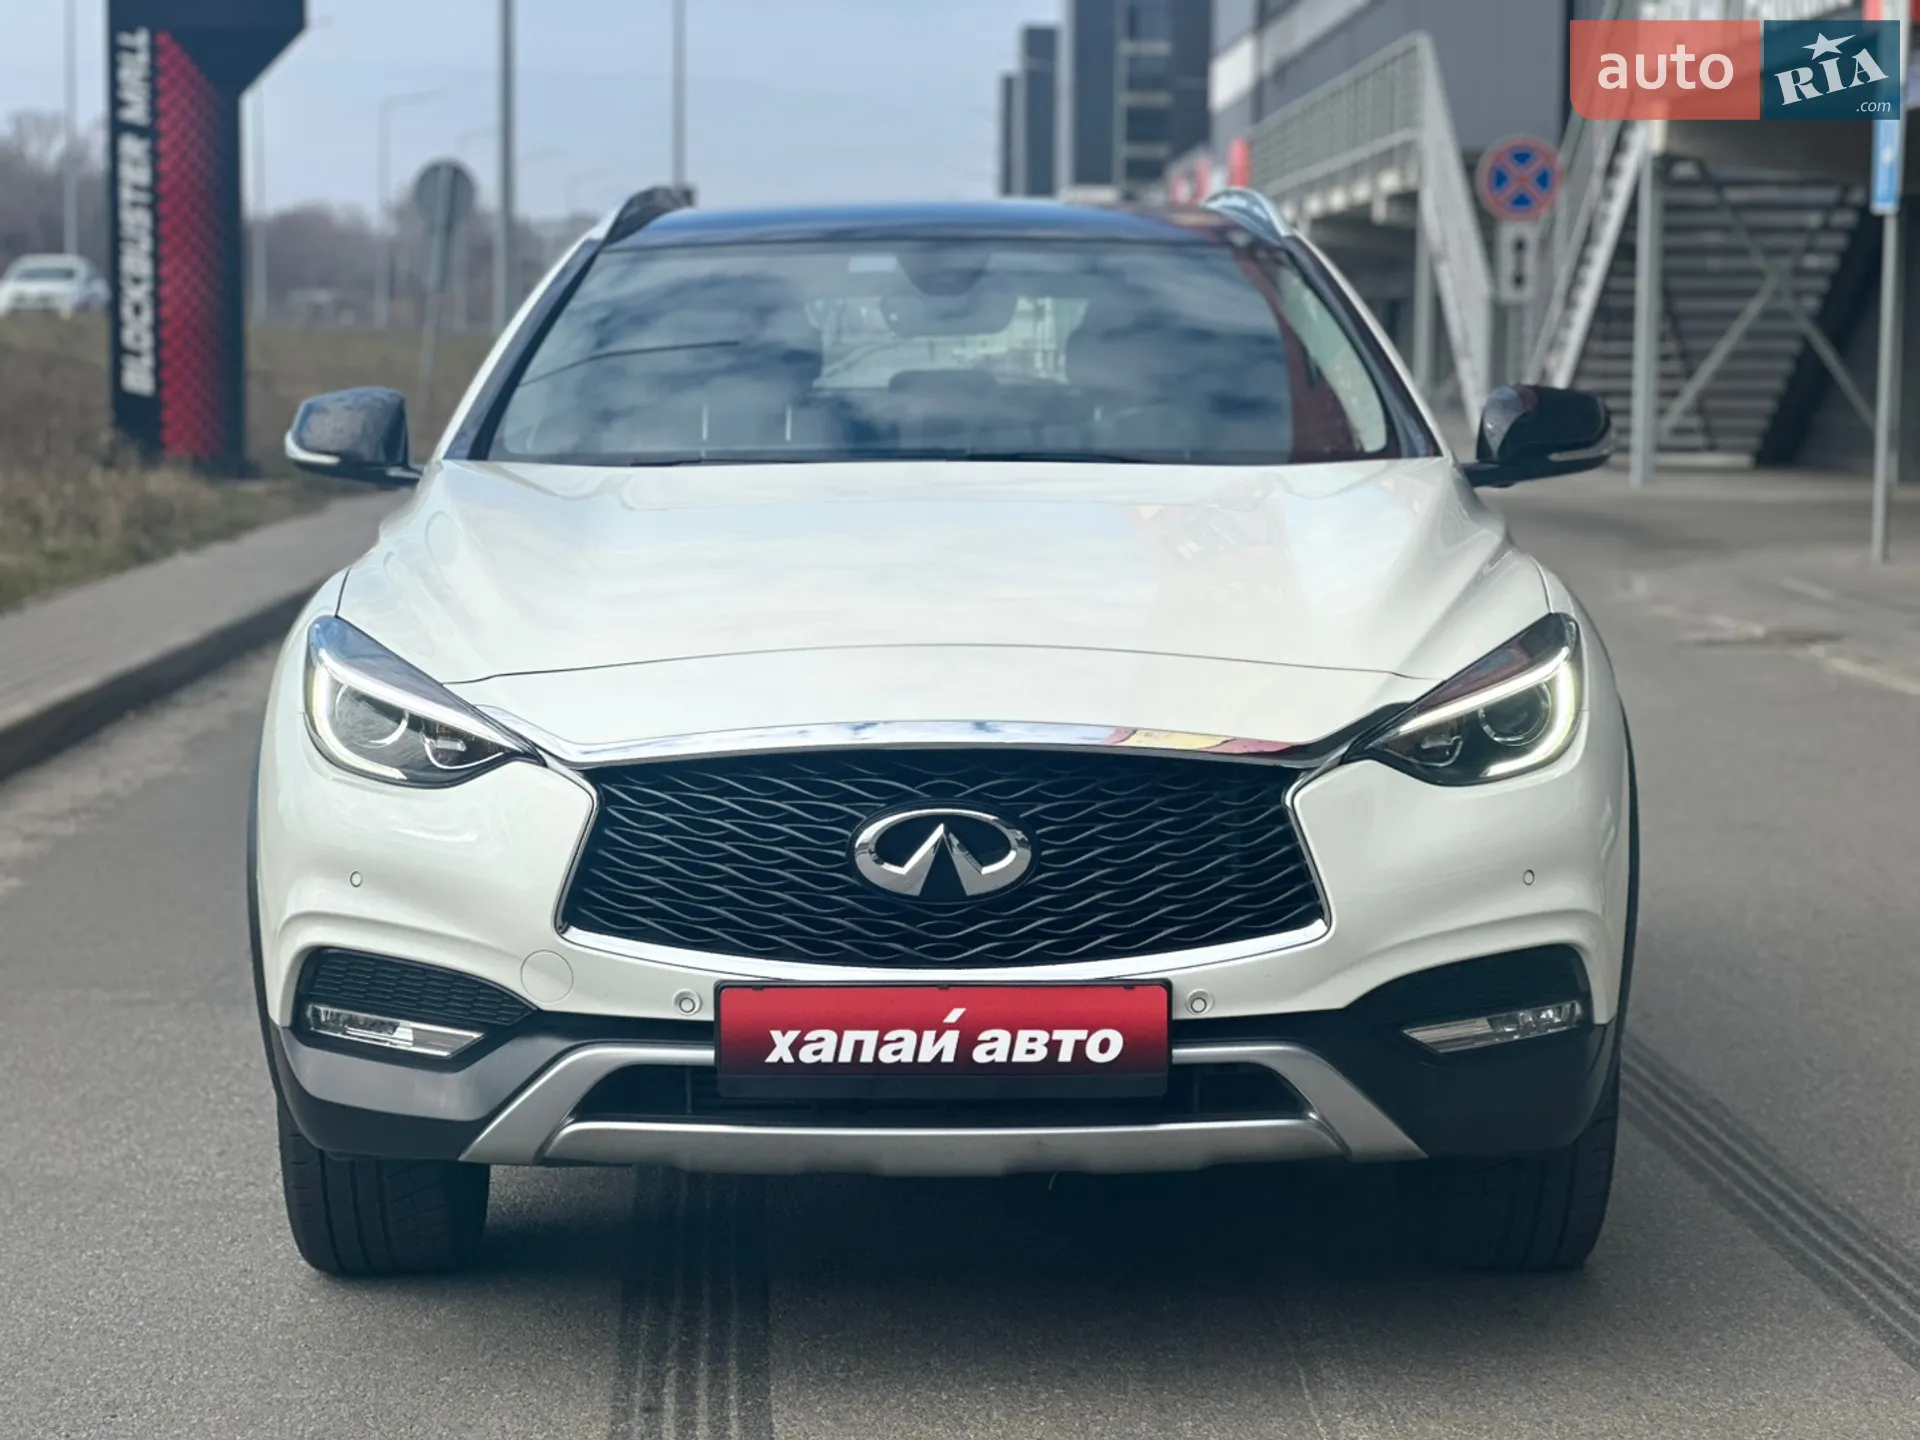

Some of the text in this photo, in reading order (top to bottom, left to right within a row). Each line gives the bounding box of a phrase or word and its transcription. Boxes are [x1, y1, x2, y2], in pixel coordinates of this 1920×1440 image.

[115, 26, 156, 397] BLOCKBUSTER MALL
[972, 1027, 1124, 1064] авто
